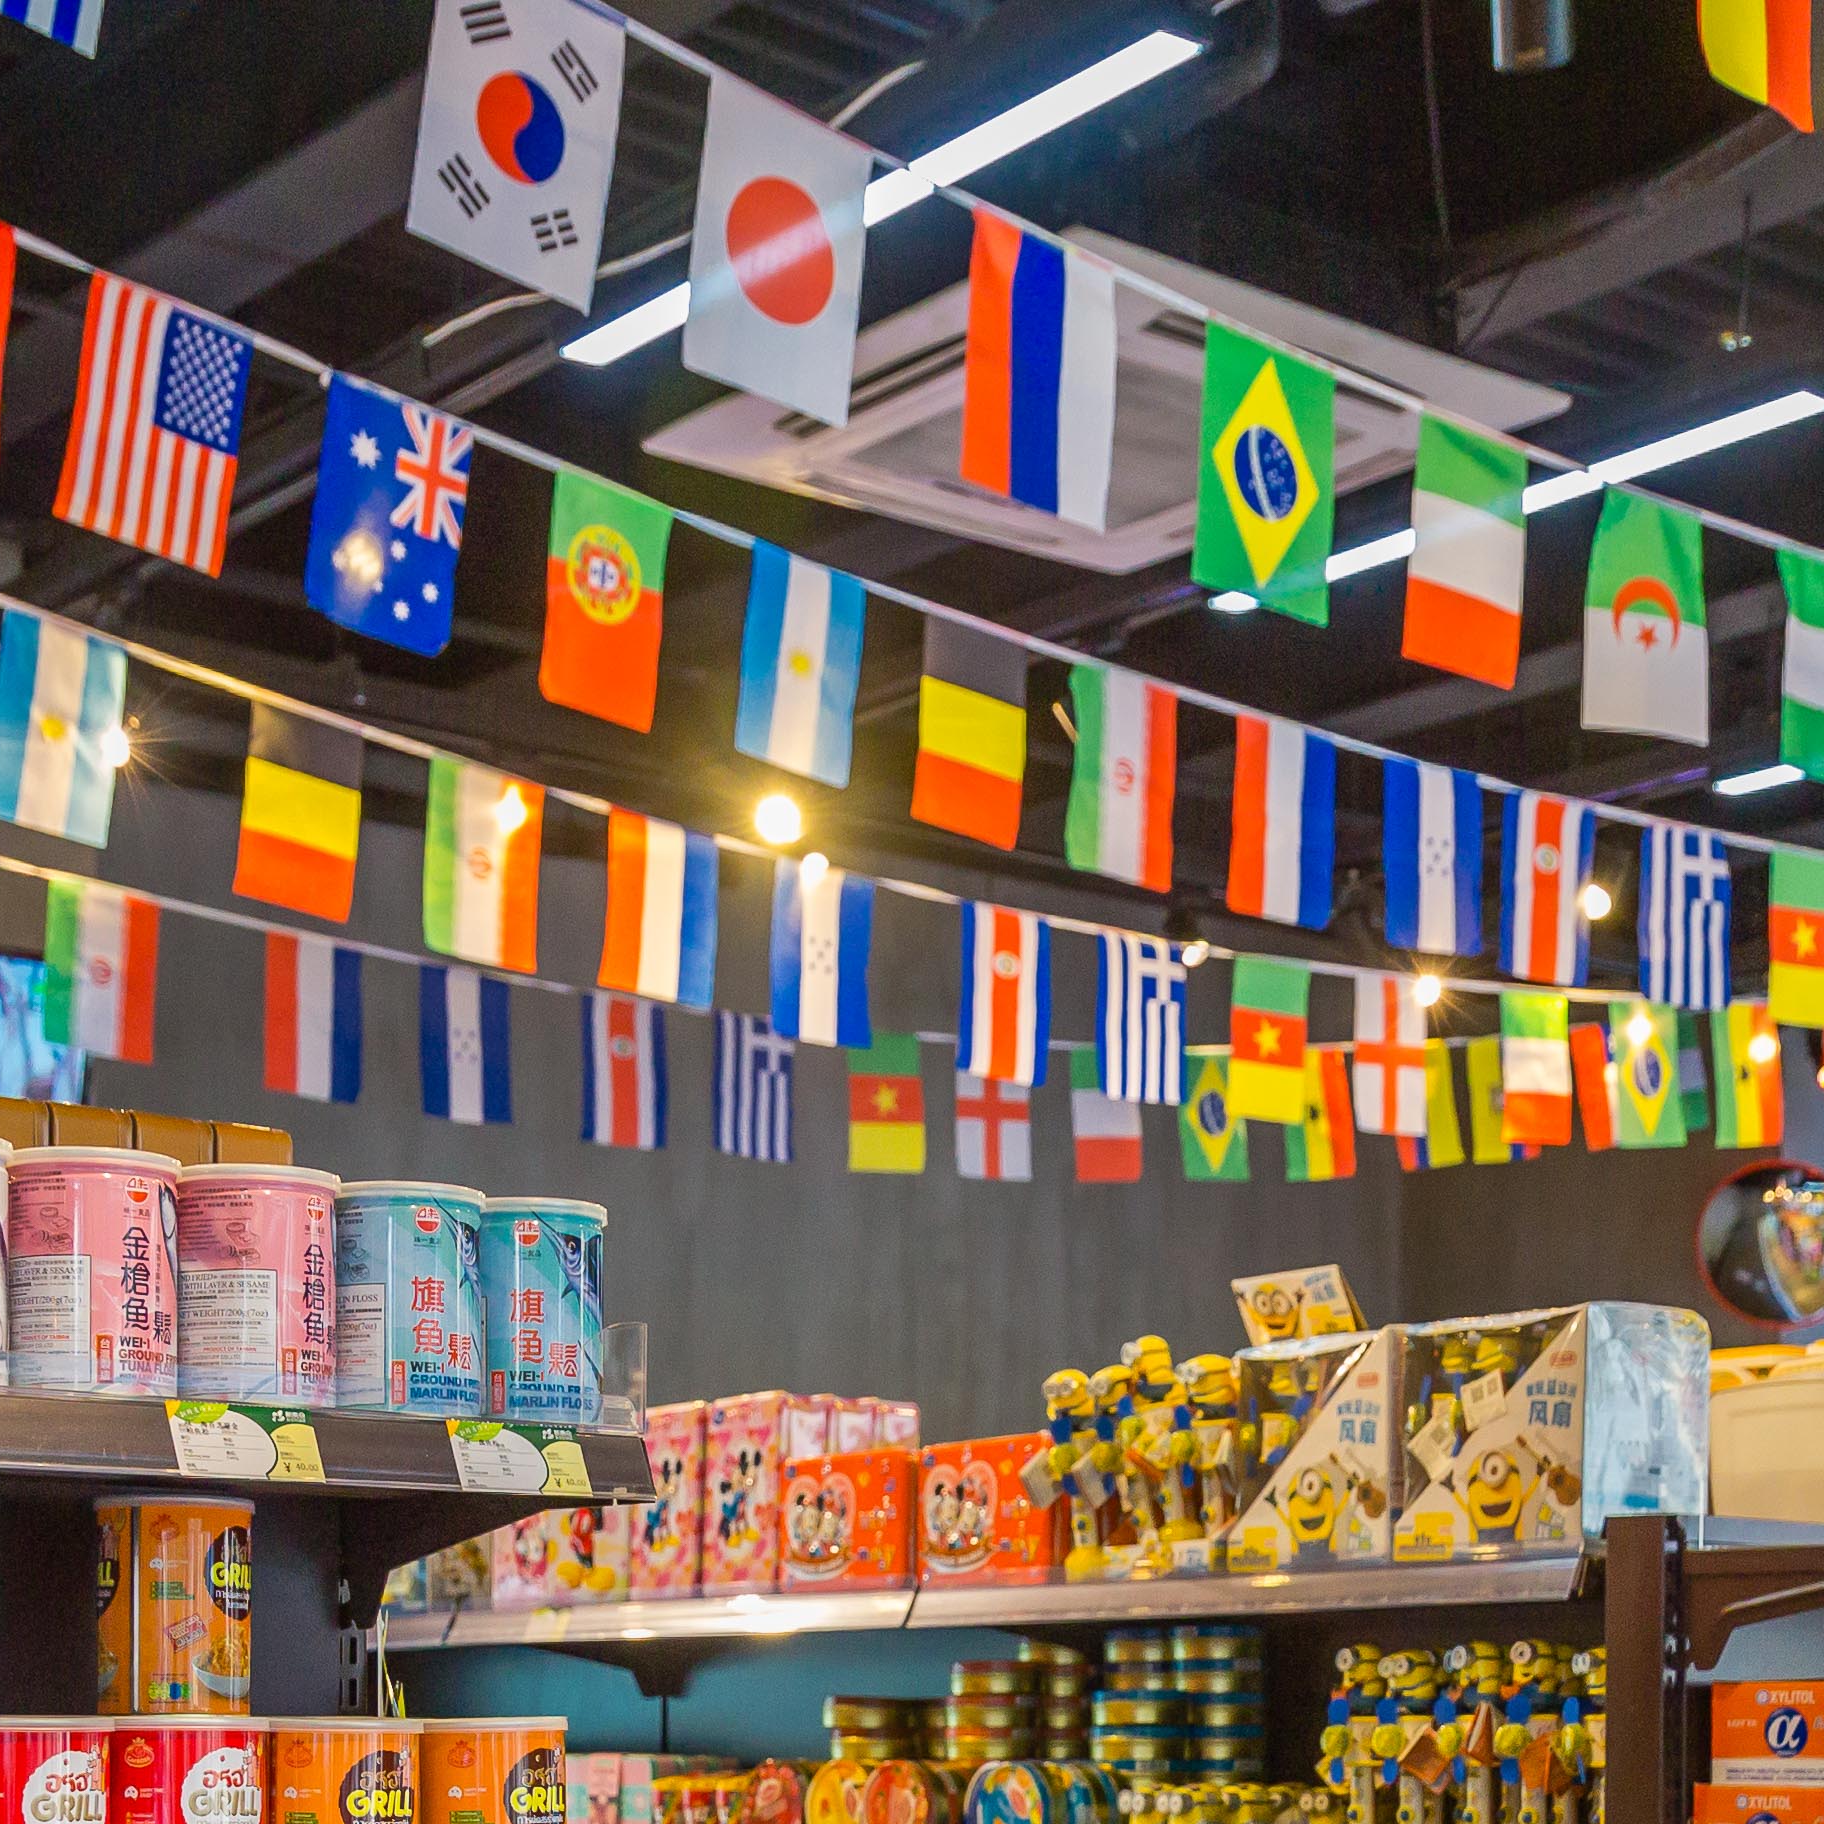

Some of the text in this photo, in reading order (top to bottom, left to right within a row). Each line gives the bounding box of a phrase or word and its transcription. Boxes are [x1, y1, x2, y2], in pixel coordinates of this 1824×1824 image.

[121, 1226, 151, 1331] 金槍魚
[410, 1276, 445, 1355] 旗魚
[509, 1288, 545, 1364] 旗魚
[410, 1361, 445, 1374] WEI-I
[410, 1374, 462, 1387] GROUND
[510, 1370, 544, 1382] WEI-I
[410, 1388, 458, 1401] MARLIN
[509, 1395, 559, 1408] MARLIN
[1769, 1690, 1815, 1705] XYLITOL
[30, 1792, 103, 1823] GRILL
[188, 1792, 258, 1818] GRILL
[346, 1787, 412, 1818] GRILL
[510, 1786, 565, 1812] GRILL
